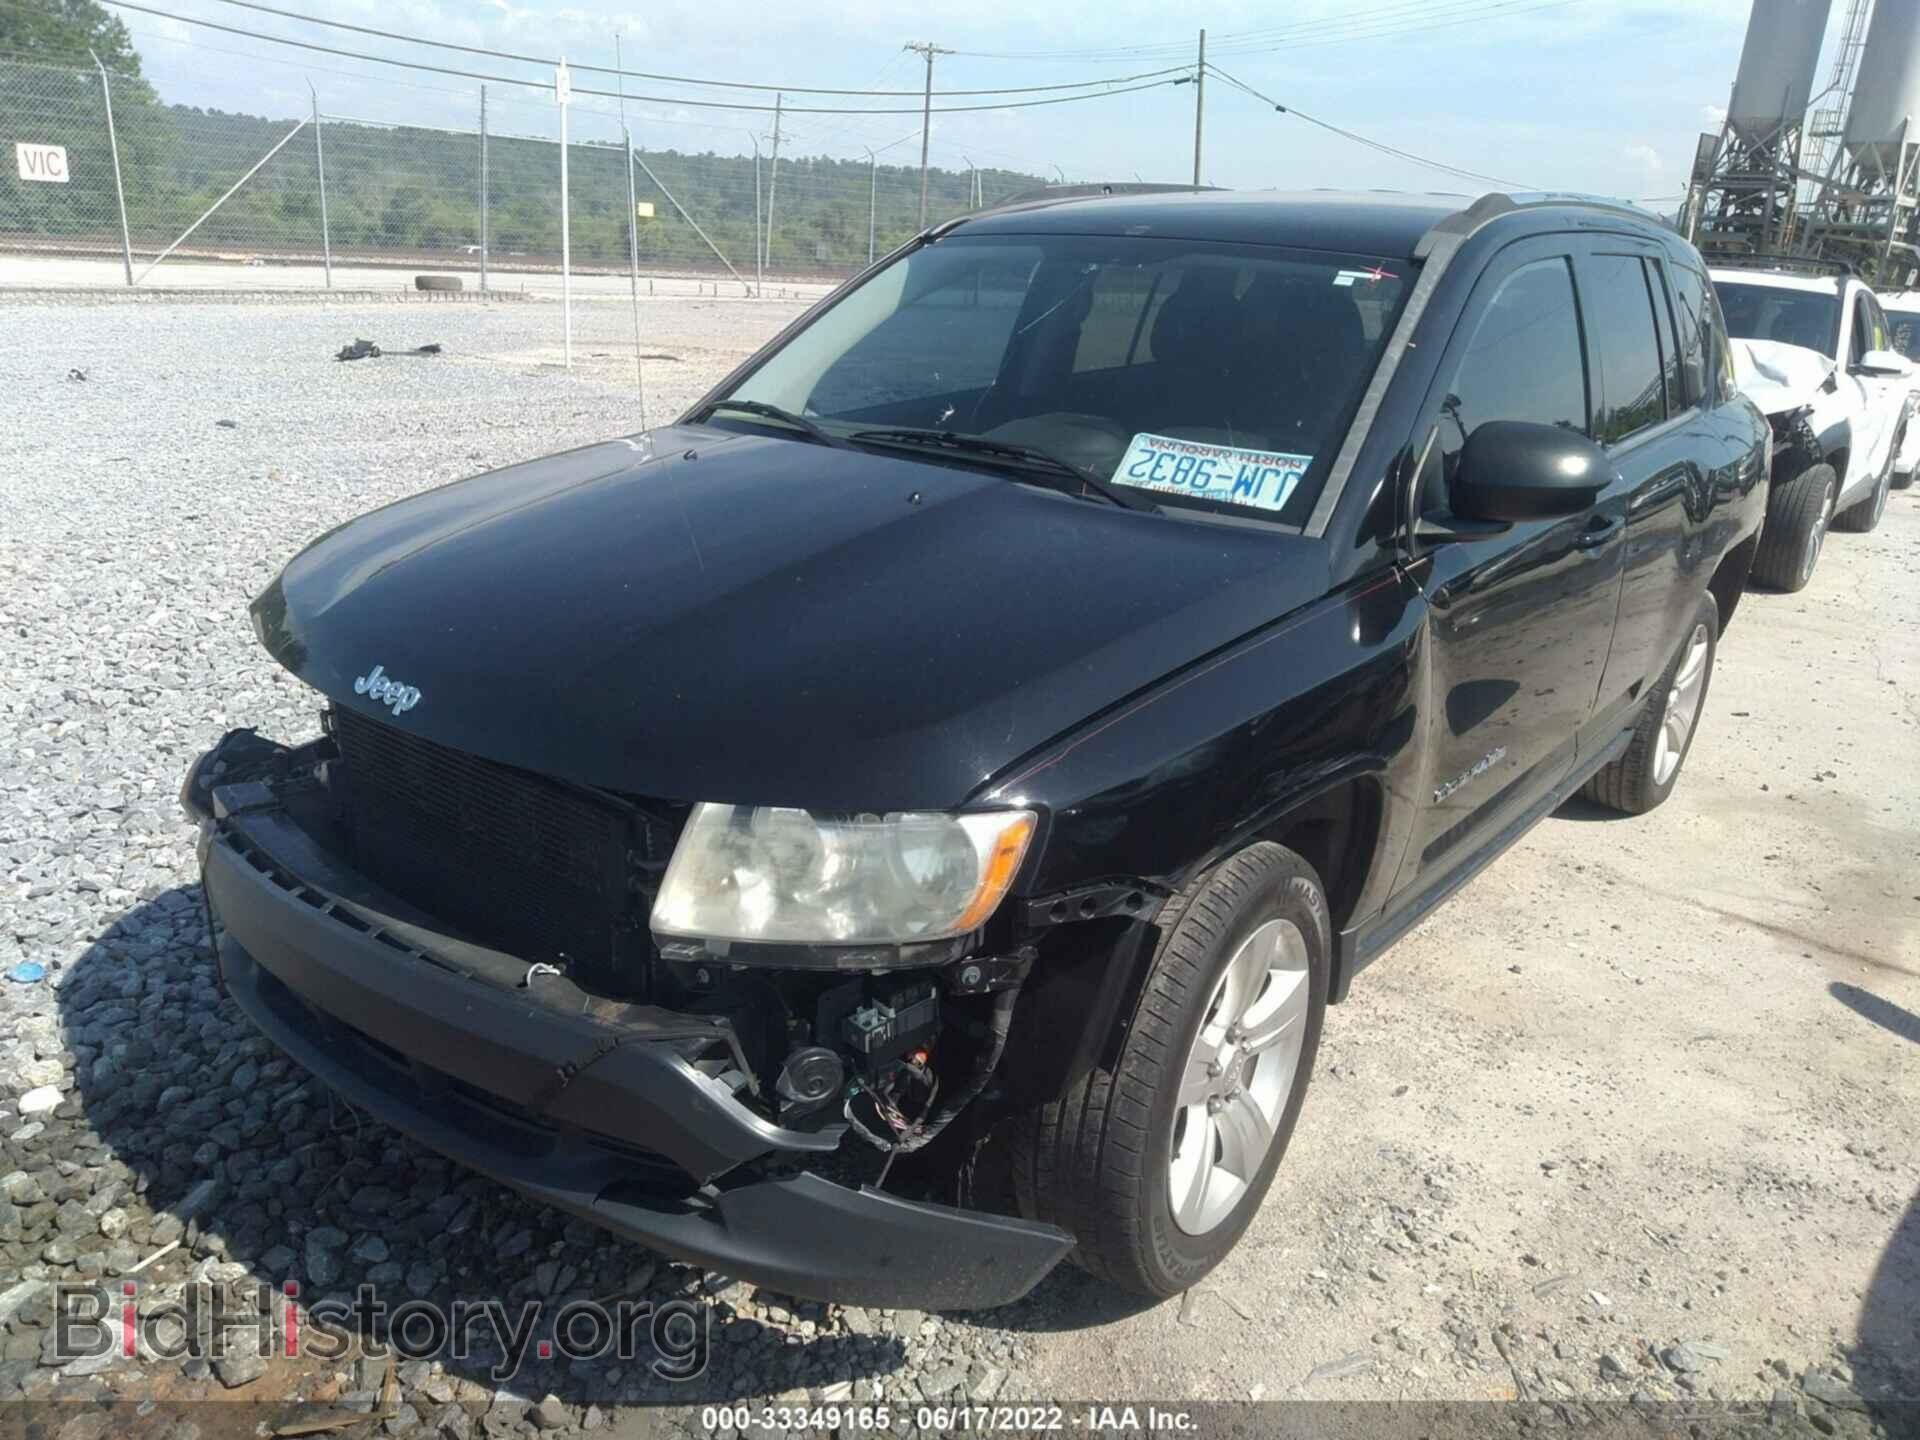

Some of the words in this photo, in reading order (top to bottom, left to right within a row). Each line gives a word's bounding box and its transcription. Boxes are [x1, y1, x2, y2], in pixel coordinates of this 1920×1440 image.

[23, 149, 62, 177] VIC
[1148, 438, 1232, 459] CAROLINA
[1239, 453, 1302, 469] NORTH
[1128, 448, 1302, 504] JJM-9832
[354, 664, 421, 716] Jeep
